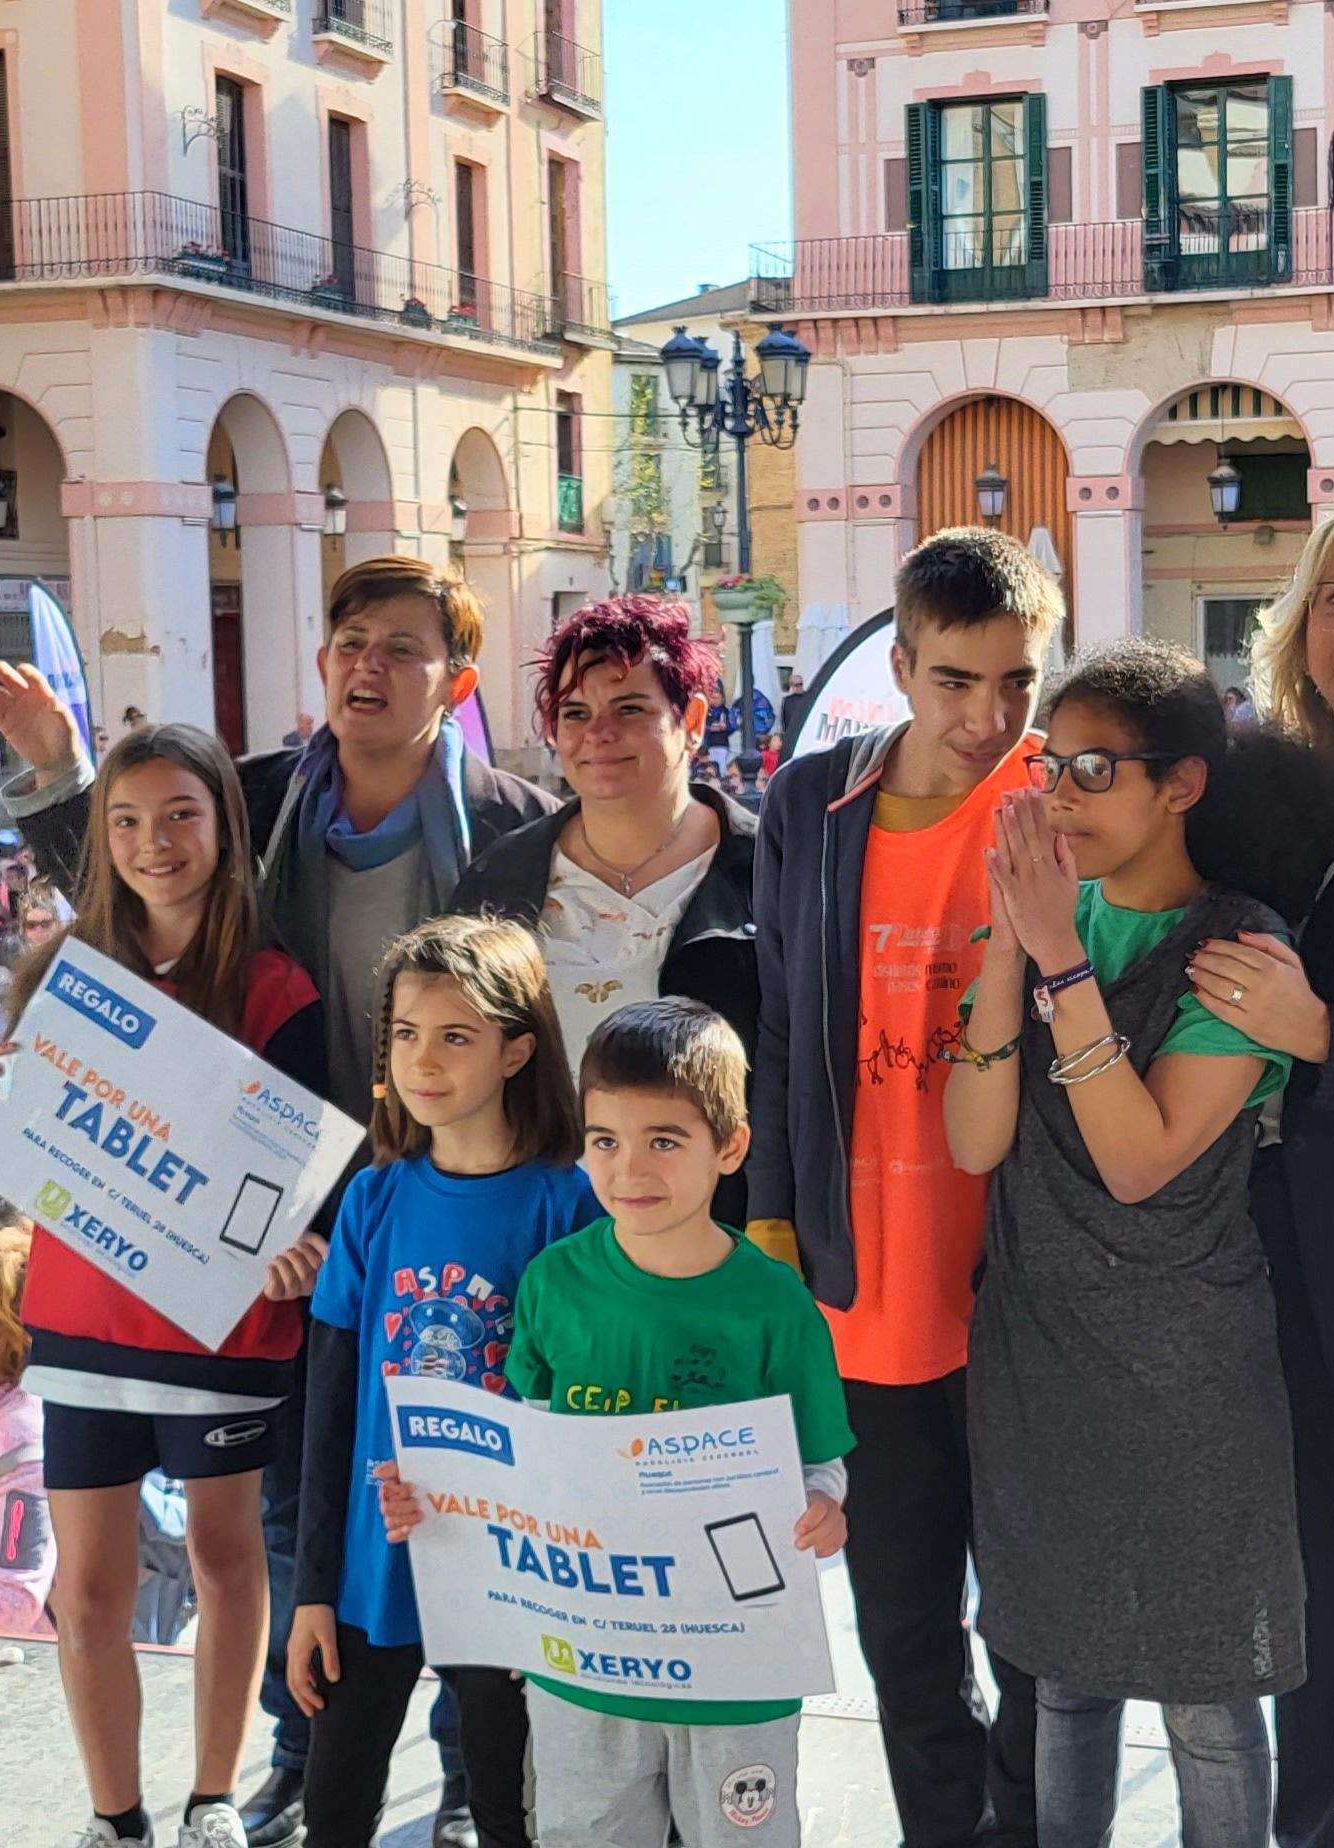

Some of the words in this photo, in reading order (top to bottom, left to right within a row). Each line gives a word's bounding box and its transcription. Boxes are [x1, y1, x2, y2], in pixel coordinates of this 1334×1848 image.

[869, 923, 892, 953] 7
[58, 972, 140, 1034] REGALO
[32, 1032, 83, 1078] VALE
[81, 1067, 126, 1107] POR
[127, 1100, 171, 1140] UNA
[257, 1088, 321, 1140] ASPAC
[55, 1080, 211, 1205] TABLET
[21, 1127, 47, 1150] PARA
[47, 1144, 92, 1181] RECOGER
[91, 1175, 107, 1190] EN
[121, 1195, 152, 1225] TERUEL
[64, 1203, 149, 1272] XERYO
[408, 1415, 503, 1451] REGALO
[648, 1426, 756, 1457] ASPACE
[427, 1492, 491, 1519] VALE
[495, 1503, 541, 1538] POR
[546, 1520, 603, 1550] UNA
[487, 1523, 675, 1597] TABLET
[487, 1590, 518, 1604] PARA
[520, 1595, 569, 1623] RECOGER
[571, 1613, 586, 1626] EN
[593, 1619, 606, 1630] C/
[610, 1620, 657, 1633] TERUEL
[660, 1622, 677, 1633] 28
[680, 1621, 745, 1634] (HUESCA)
[577, 1648, 692, 1681] XERYO
